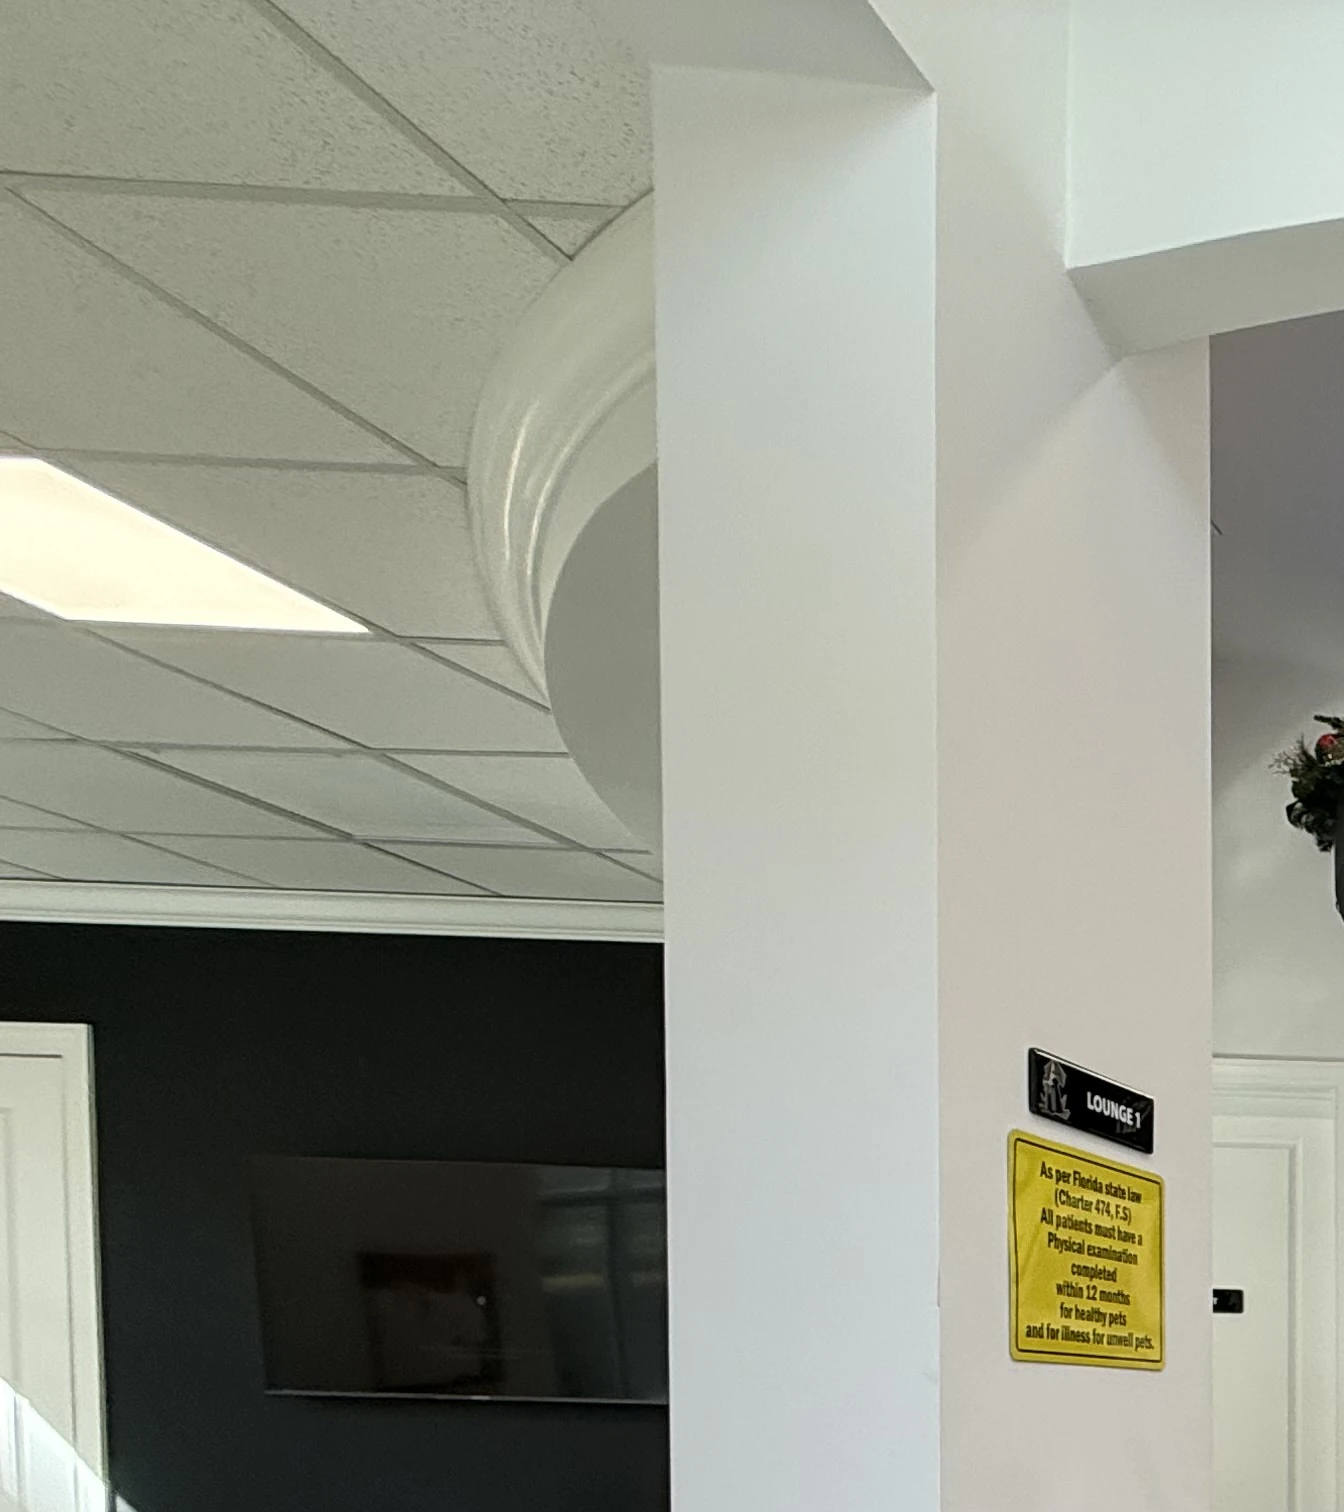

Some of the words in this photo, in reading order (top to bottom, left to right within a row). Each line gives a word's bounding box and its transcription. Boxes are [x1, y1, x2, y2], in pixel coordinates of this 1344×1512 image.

[1086, 1091, 1134, 1126] LOUNGE
[1134, 1111, 1142, 1129] 1
[1040, 1160, 1053, 1180] As
[1055, 1168, 1071, 1185] per
[1073, 1170, 1104, 1194] Florida
[1105, 1182, 1126, 1200] state
[1127, 1186, 1142, 1204] law
[1094, 1198, 1114, 1221] 474,
[1040, 1207, 1054, 1226] All
[1055, 1214, 1093, 1235] patients
[1094, 1224, 1116, 1241] must
[1117, 1226, 1137, 1245] have
[1137, 1234, 1143, 1246] a
[1047, 1231, 1085, 1255] Physical
[1087, 1243, 1138, 1266] examination
[1070, 1262, 1117, 1283] completed
[1056, 1280, 1084, 1299] within
[1085, 1284, 1098, 1301] 12
[1099, 1289, 1131, 1306] months
[1059, 1301, 1074, 1319] for
[1075, 1304, 1108, 1327] healthy
[1108, 1311, 1127, 1328] pets
[1025, 1322, 1045, 1339] and
[1046, 1323, 1060, 1341] for
[1061, 1325, 1091, 1344] illness
[1092, 1328, 1105, 1345] for
[1106, 1332, 1134, 1348] unwell
